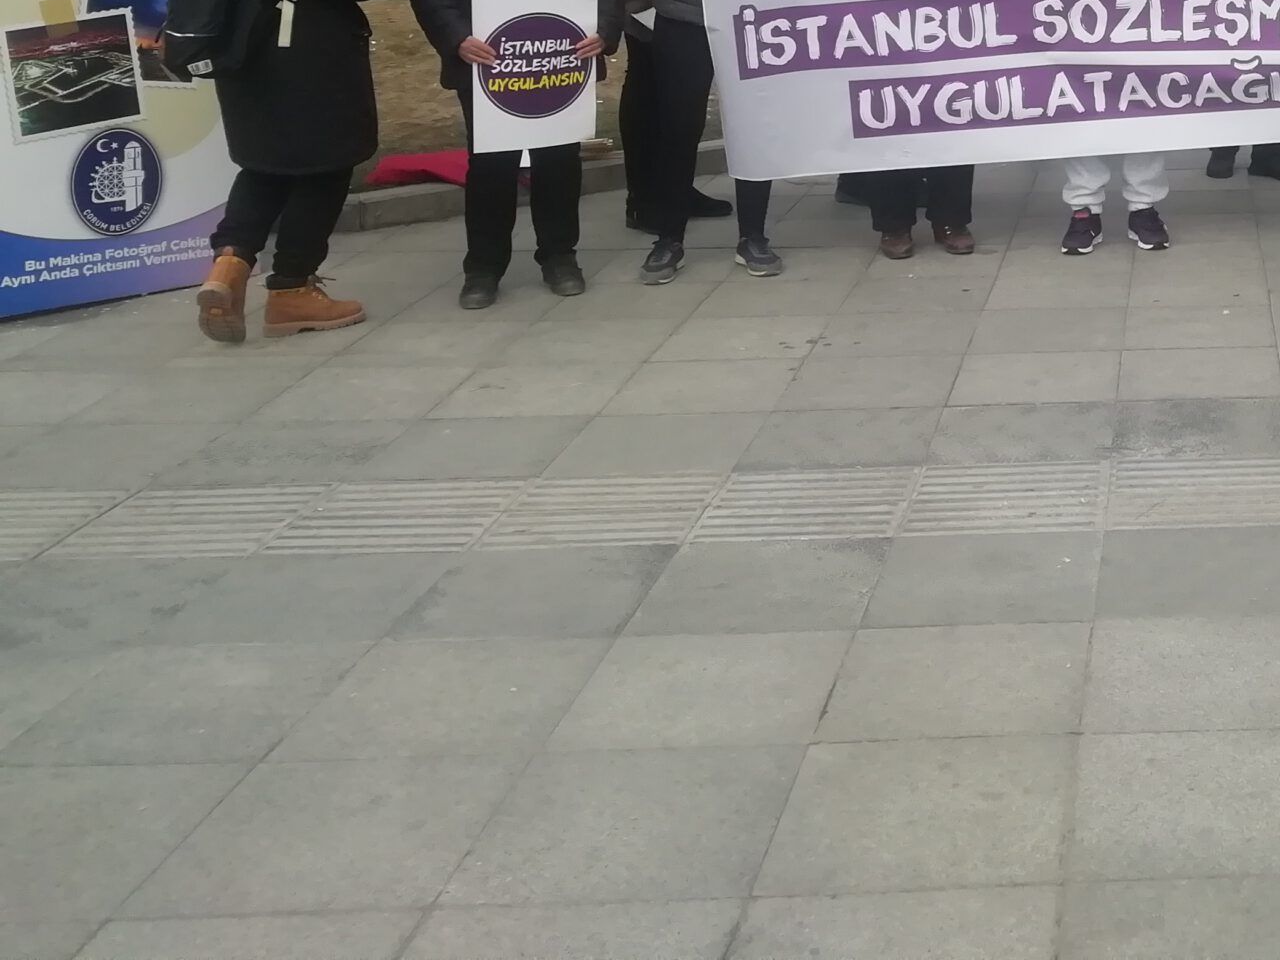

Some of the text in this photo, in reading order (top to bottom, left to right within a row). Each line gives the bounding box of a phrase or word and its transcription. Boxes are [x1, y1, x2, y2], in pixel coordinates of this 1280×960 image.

[499, 37, 576, 56] İSTANBUL
[742, 3, 1018, 70] İSTANBUL
[488, 71, 585, 92] UYGULANSIN
[25, 260, 45, 272] Bu
[49, 251, 102, 268] Makina
[105, 240, 167, 259] Fotoğraf
[0, 274, 35, 288] Aynı
[39, 268, 79, 282] Anda
[83, 259, 140, 277] Çıktısını
